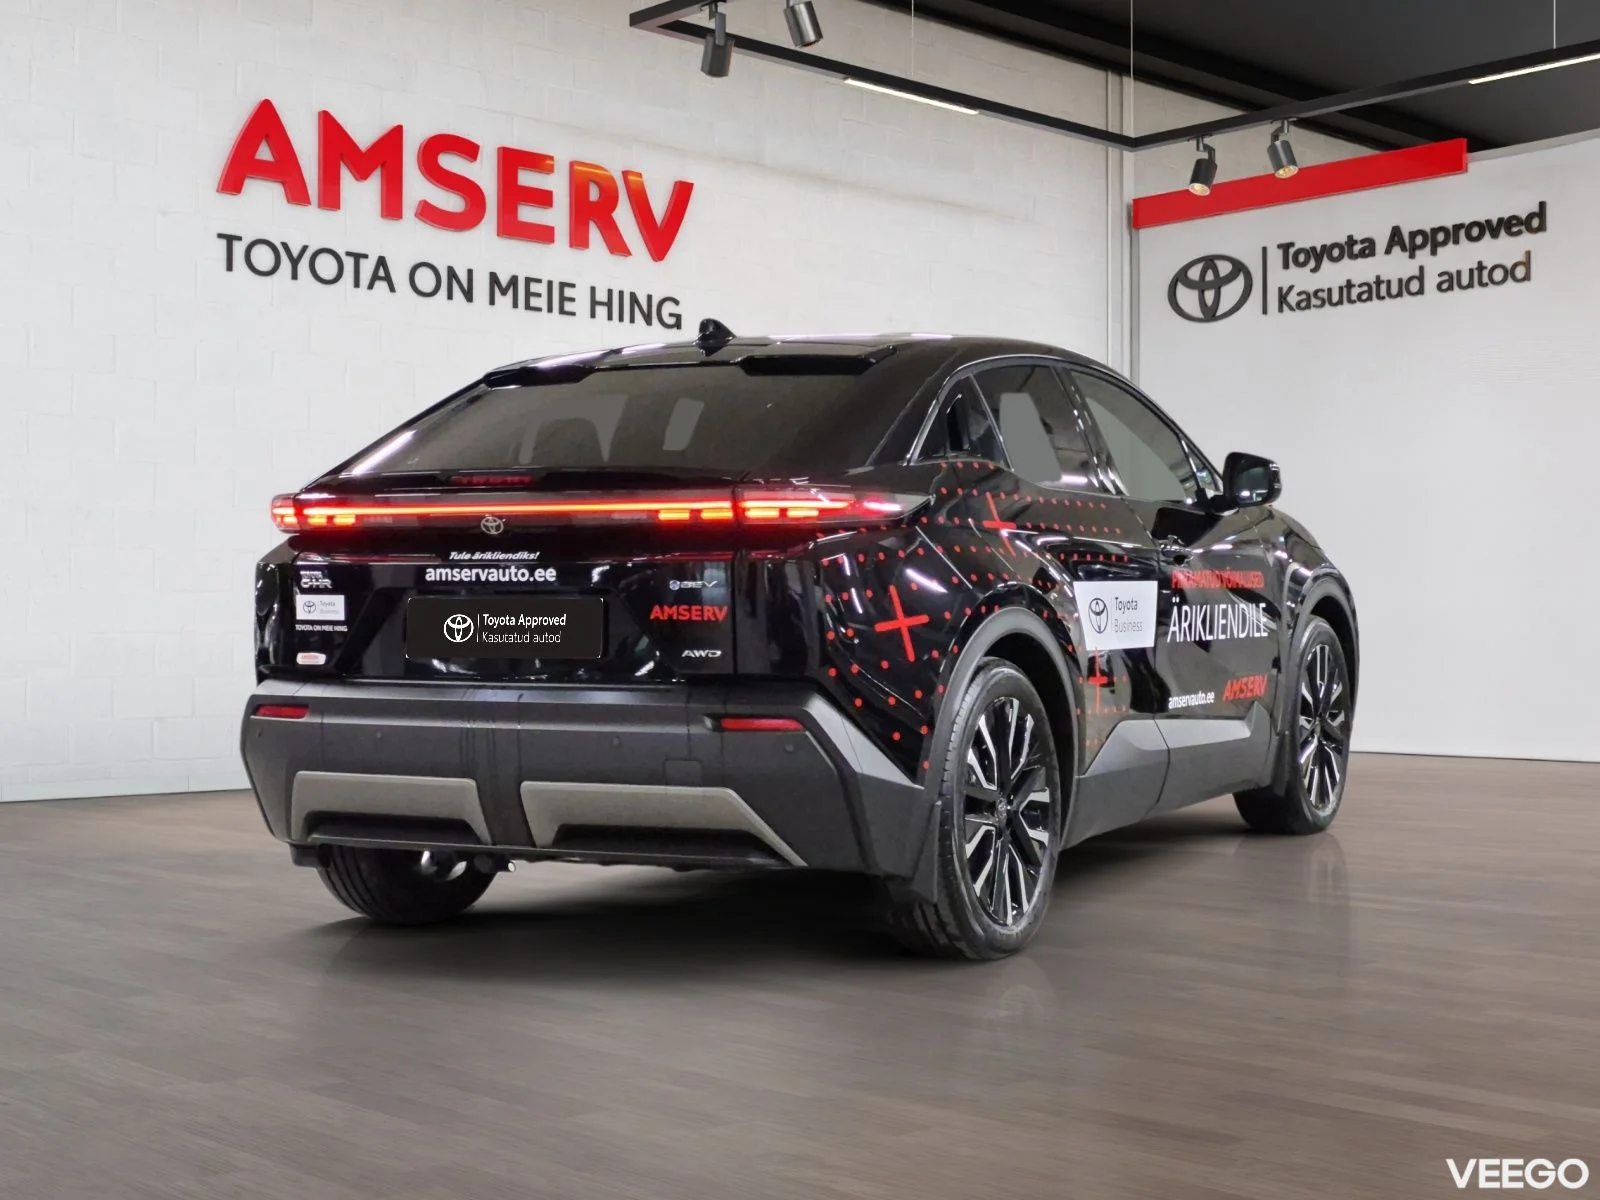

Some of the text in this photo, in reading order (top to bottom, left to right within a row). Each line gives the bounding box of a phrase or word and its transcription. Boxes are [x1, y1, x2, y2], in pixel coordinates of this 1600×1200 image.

[215, 98, 695, 262] AMSERV
[1277, 200, 1547, 273] Toyota Approved
[216, 232, 682, 330] TOYOTA ON MEIE HING
[1277, 250, 1532, 314] Kasutatud autod
[449, 551, 541, 561] Tule ärikliendiks!
[425, 565, 557, 582] amservauto.ee
[650, 604, 728, 622] AMSERV
[1114, 597, 1138, 614] Toyota
[482, 613, 567, 629] Toyota Approved
[1114, 619, 1144, 633] Business
[1167, 597, 1269, 643] ÄRIKLIENDILE
[482, 631, 530, 643] Kasutatud
[681, 649, 722, 658] AWD
[1223, 675, 1268, 701] AMSERV
[1168, 691, 1215, 709] amservauto.ee
